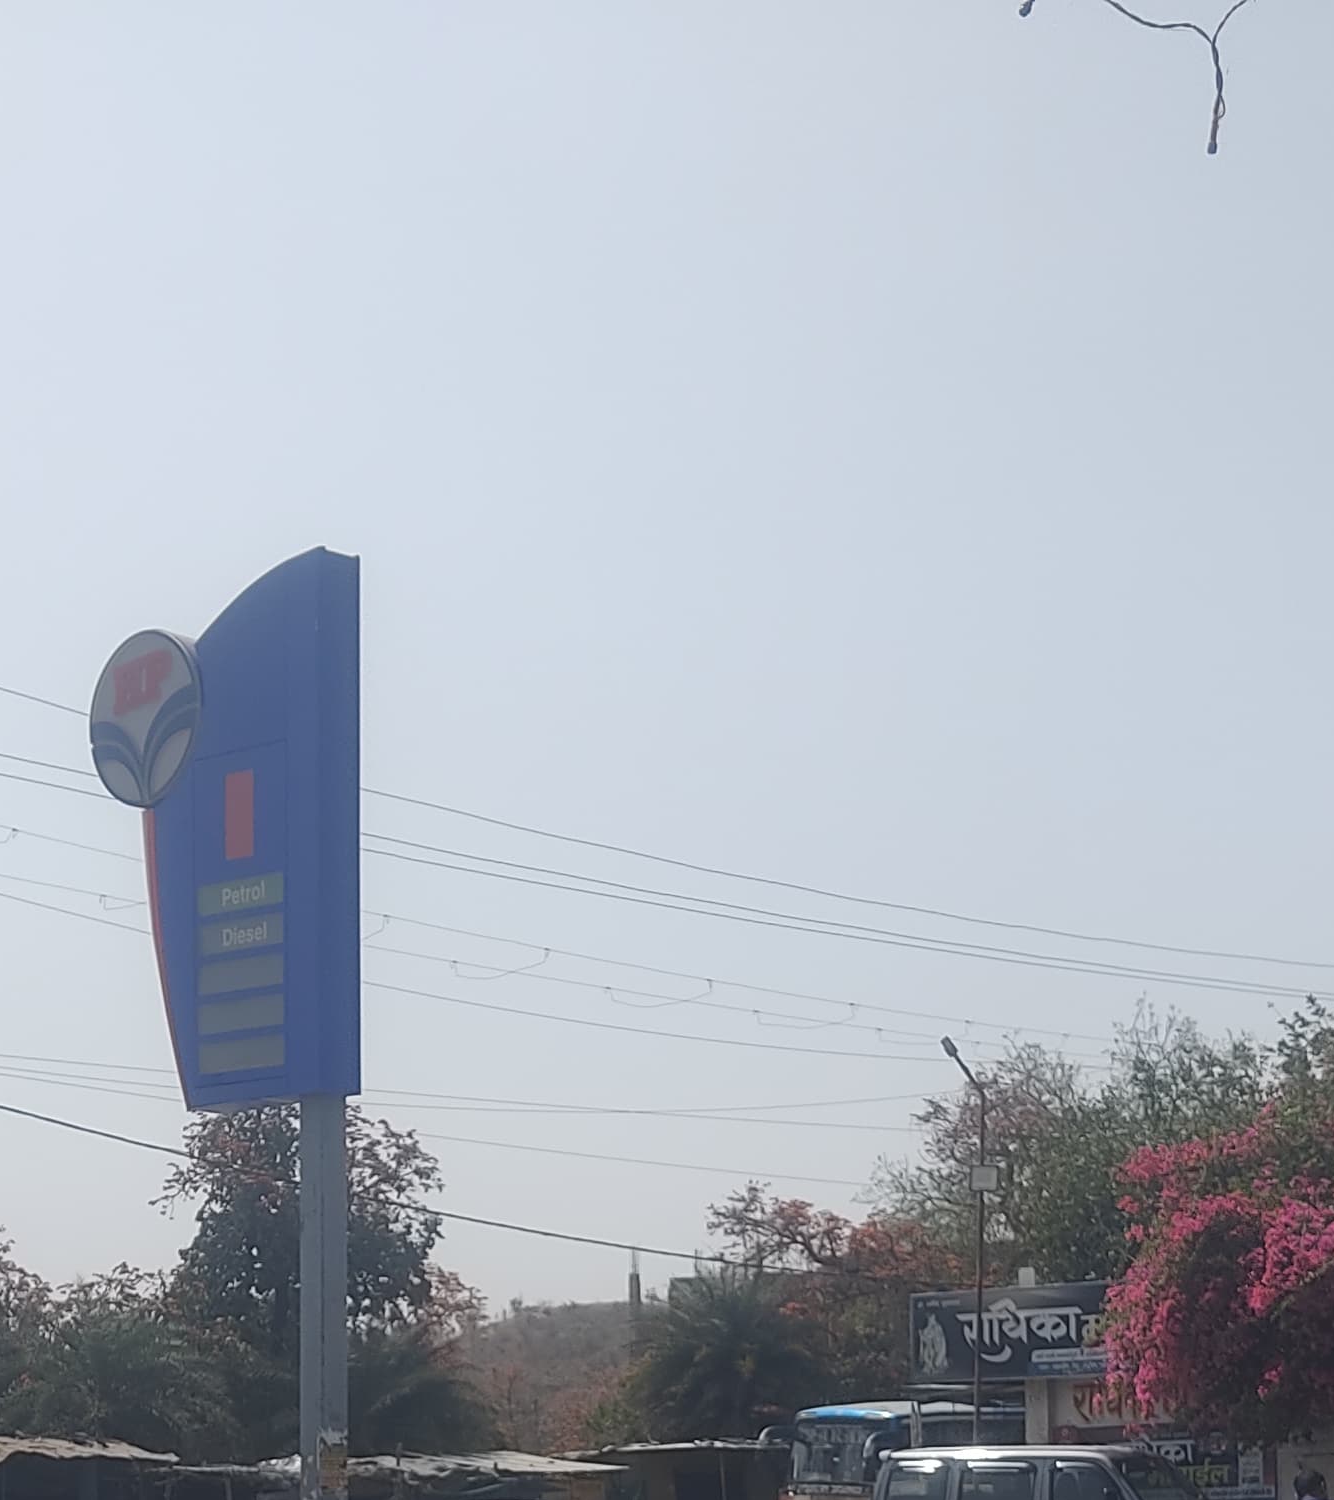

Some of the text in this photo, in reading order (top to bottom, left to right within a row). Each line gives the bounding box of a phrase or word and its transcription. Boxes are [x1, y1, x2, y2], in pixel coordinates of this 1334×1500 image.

[113, 650, 173, 717] HP
[221, 879, 266, 908] Petrol
[221, 920, 268, 947] Diesel
[955, 1297, 1084, 1364] राधिका
